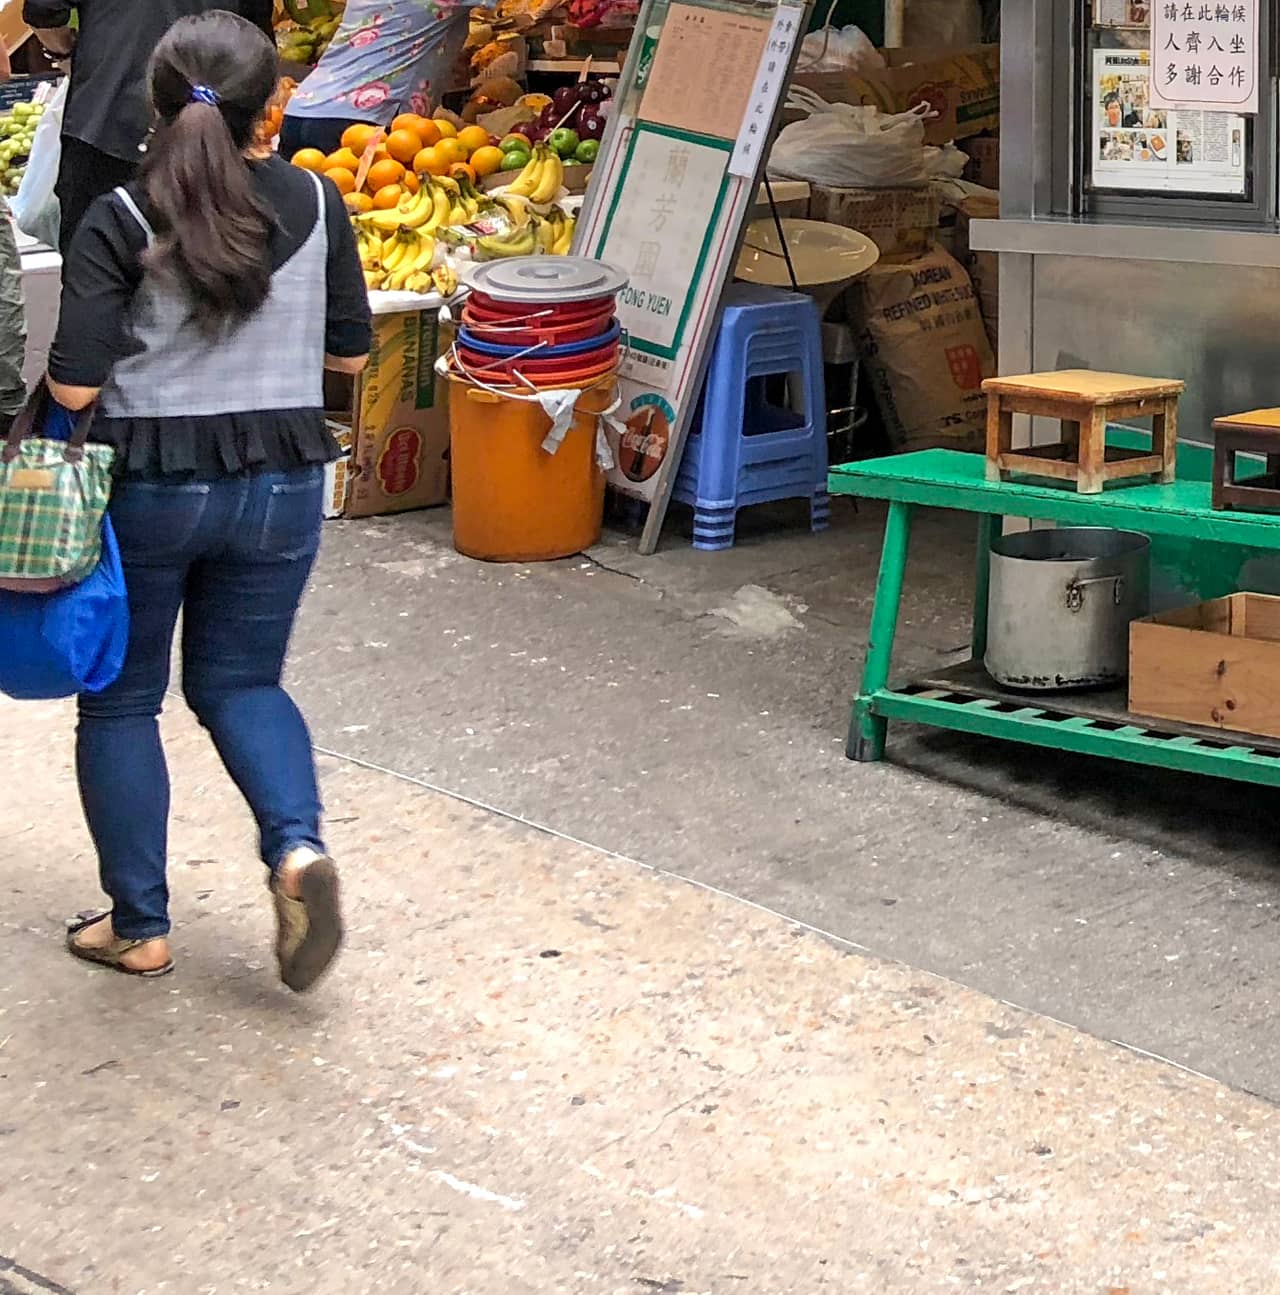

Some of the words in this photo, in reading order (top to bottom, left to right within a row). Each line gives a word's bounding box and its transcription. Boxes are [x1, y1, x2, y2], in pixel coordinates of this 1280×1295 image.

[1163, 3, 1247, 23] 請在此輪候
[1163, 31, 1247, 55] 人齊入坐
[1164, 63, 1247, 88] 多謝合作
[647, 291, 673, 317] YUEN
[882, 293, 932, 322] REFINED
